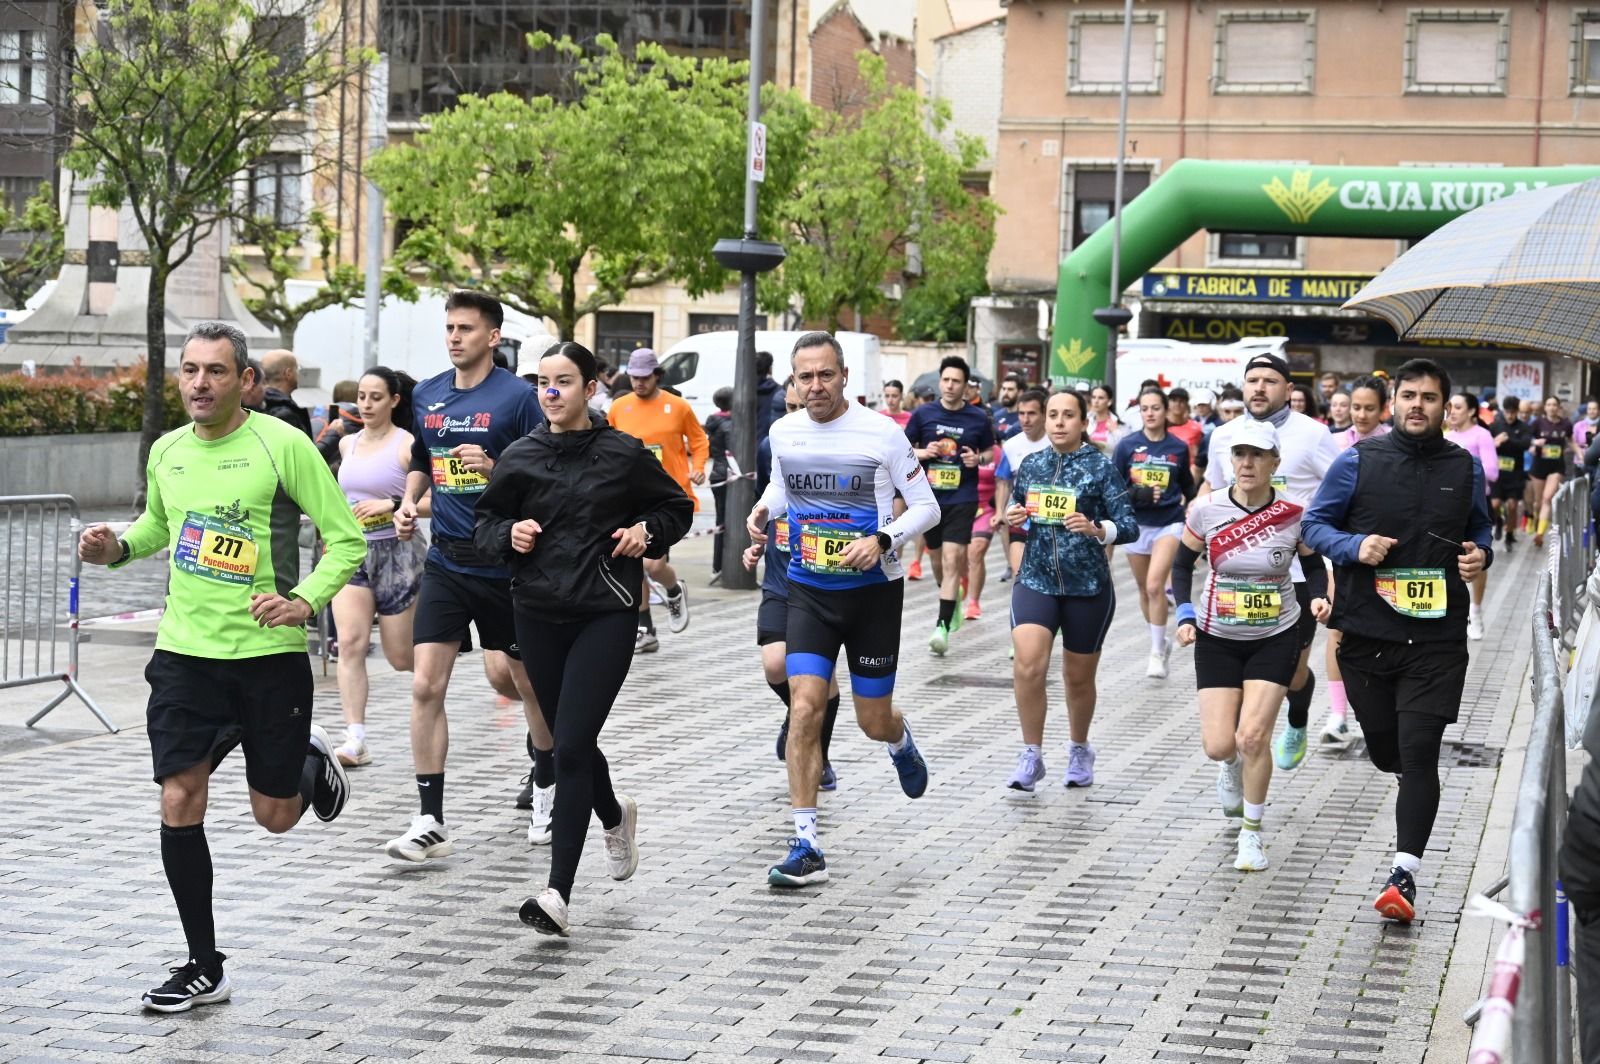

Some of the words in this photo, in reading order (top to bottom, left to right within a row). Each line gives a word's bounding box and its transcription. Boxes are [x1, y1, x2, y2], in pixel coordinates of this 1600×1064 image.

[1339, 180, 1427, 212] CAJA
[1430, 181, 1549, 211] RUR
[1187, 276, 1258, 296] FABRICA
[1268, 278, 1292, 297] DE
[1166, 319, 1287, 339] ALONSO
[1503, 362, 1540, 386] OFERTA
[1178, 379, 1211, 389] Cruz
[473, 412, 492, 427] 26
[449, 460, 478, 476] 83
[939, 470, 956, 480] 925
[1146, 471, 1164, 482] 952
[787, 473, 862, 491] CEACTIVO
[1044, 495, 1068, 510] 642
[1217, 536, 1232, 546] LA
[1230, 503, 1289, 540] DESPENSA
[212, 535, 244, 559] 277
[824, 539, 853, 556] 64
[1225, 547, 1242, 560] DE
[1242, 524, 1279, 552] FER
[203, 556, 250, 574] Pucelano23
[1406, 581, 1434, 599] 671
[1243, 594, 1273, 609] 964
[1411, 601, 1432, 610] Pablo
[1247, 611, 1269, 619] Melisa
